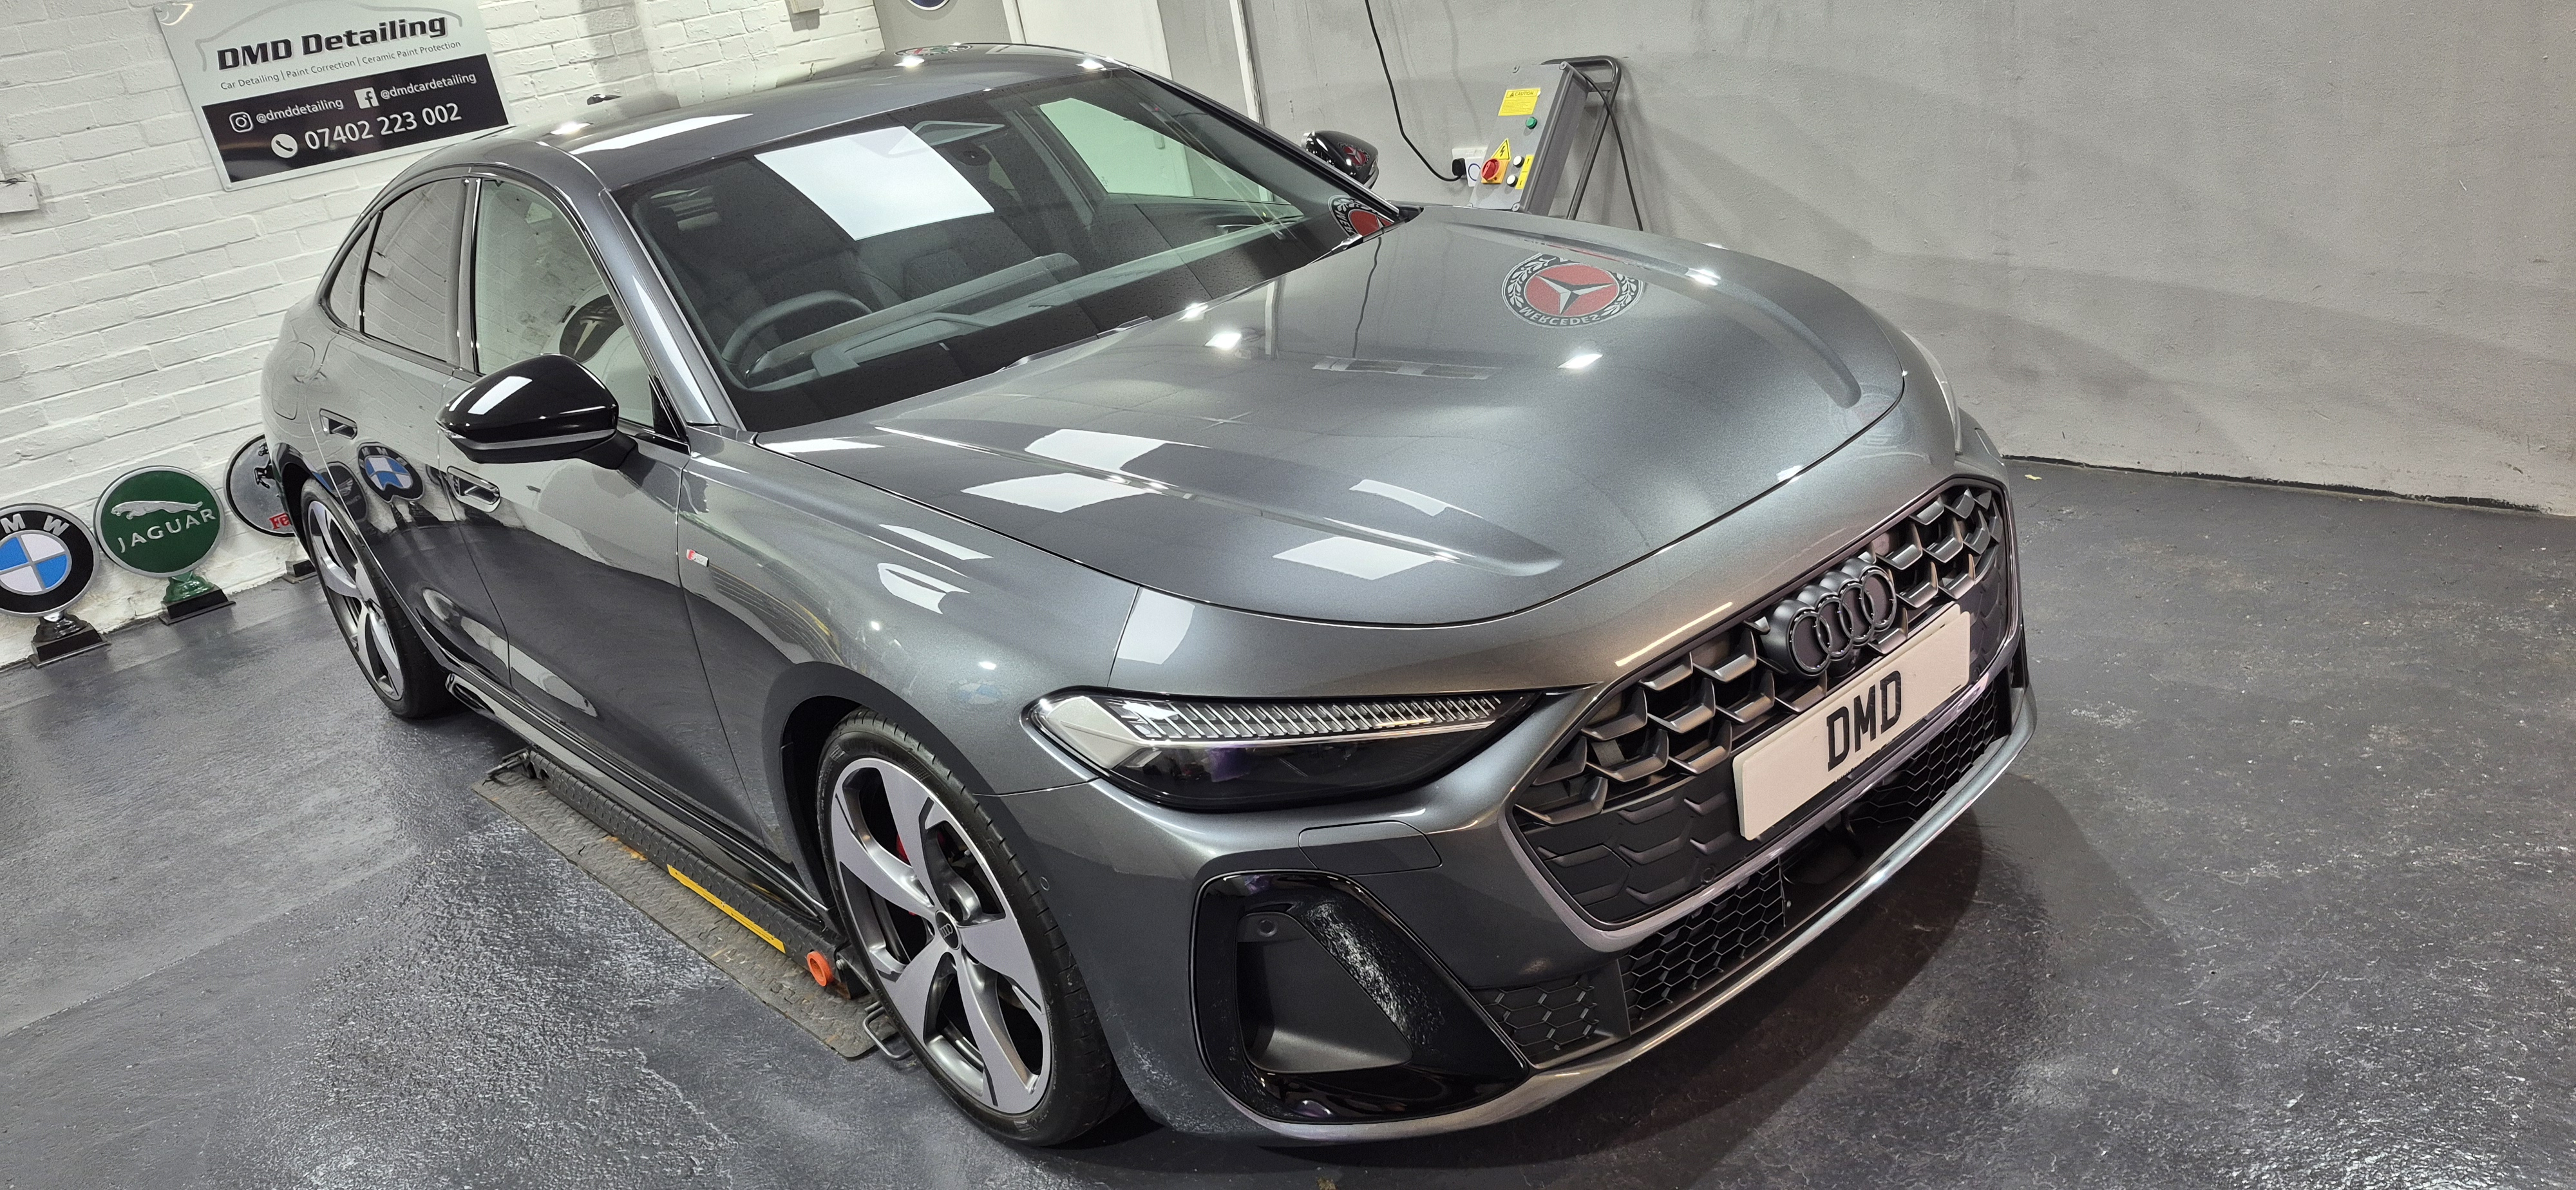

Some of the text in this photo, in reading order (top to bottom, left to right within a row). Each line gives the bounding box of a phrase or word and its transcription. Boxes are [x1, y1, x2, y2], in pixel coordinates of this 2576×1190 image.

[217, 17, 447, 70] DMD Detailing
[220, 41, 461, 90] Car Detailing Paint Correction Ceramic Paint Protection
[381, 73, 477, 100] @dmdcardetailing
[256, 99, 345, 124] @dmddetailing
[305, 103, 462, 149] 07402 223 002
[0, 513, 70, 536] MW
[118, 509, 216, 553] JAGUAR
[1826, 670, 1902, 773] DMD
